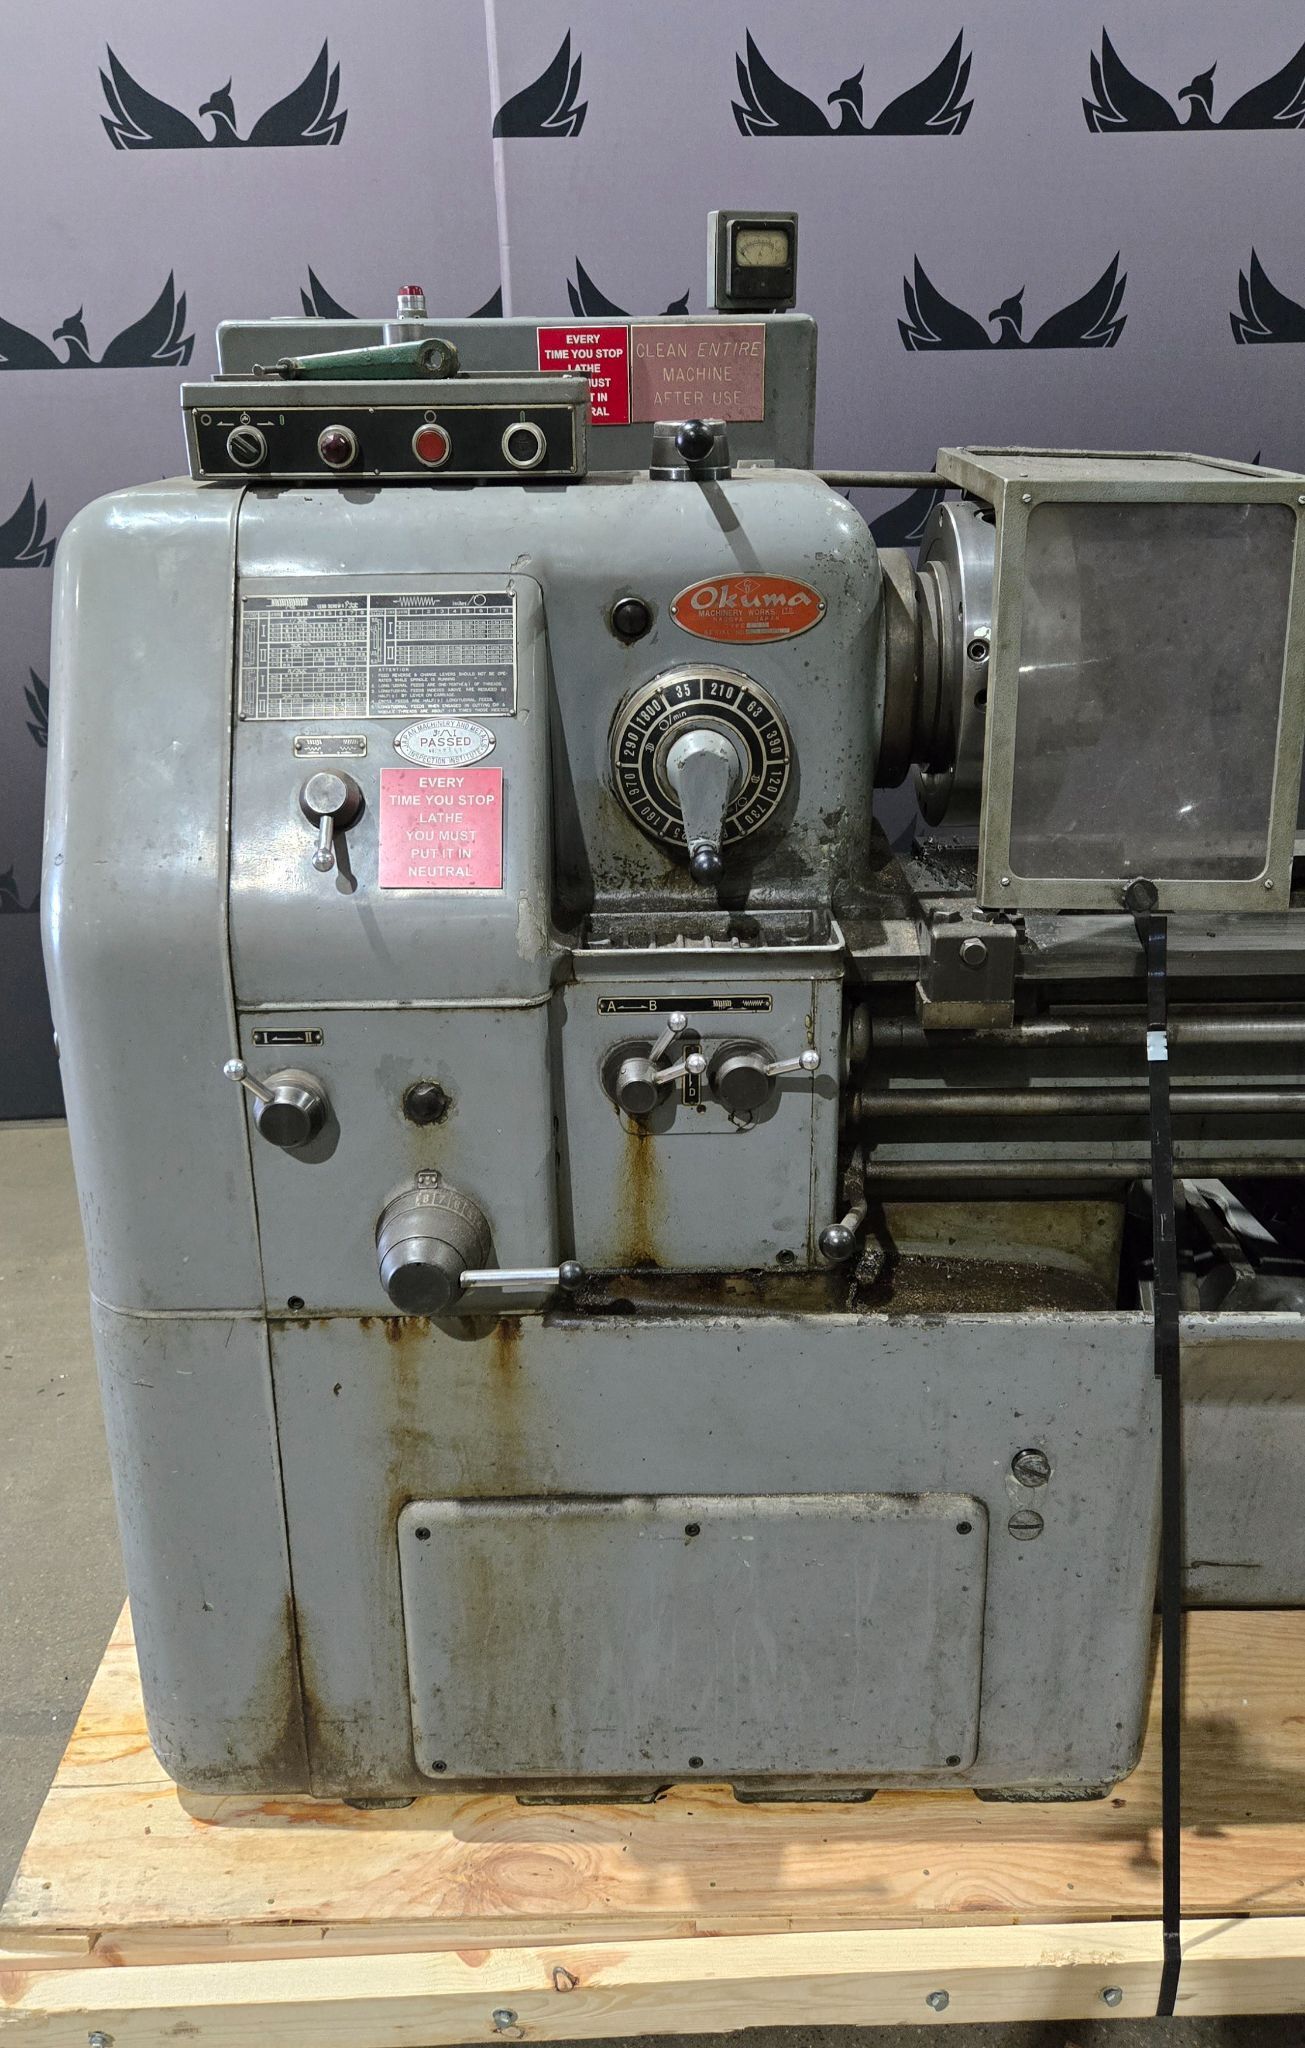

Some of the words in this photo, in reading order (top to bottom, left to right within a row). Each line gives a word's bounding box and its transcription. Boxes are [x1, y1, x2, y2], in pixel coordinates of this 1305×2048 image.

[566, 334, 600, 344] EVERY
[544, 350, 569, 360] TIME
[571, 349, 594, 358] YOU
[596, 349, 624, 358] STOP
[636, 342, 687, 358] CLEAN
[698, 342, 762, 358] ENTIRE
[568, 364, 600, 373] LATHE
[663, 367, 732, 382] MACHINE
[588, 378, 611, 388] UST
[598, 392, 608, 402] IN
[654, 392, 704, 406] AFTER
[713, 391, 742, 405] USE
[690, 584, 812, 610] Okuma
[676, 684, 690, 698] 35
[711, 683, 734, 699] 210
[636, 700, 662, 727] 1800
[746, 701, 762, 718] 63
[401, 728, 416, 748] JAPAN
[418, 721, 455, 732] MACHINERY
[420, 737, 471, 747] PASSED
[624, 732, 638, 757] 290
[766, 730, 782, 754] 390
[409, 750, 446, 764] INSPECTION
[449, 747, 481, 763] INSTITUTE
[419, 777, 464, 788] EVERY
[625, 773, 639, 795] 970
[766, 771, 782, 793] 120
[389, 795, 420, 806] TIME
[425, 795, 454, 805] YOU
[458, 795, 495, 805] STOP
[420, 813, 463, 823] LATHE
[641, 806, 660, 824] 160
[745, 804, 766, 824] 730
[406, 830, 434, 841] YOU
[439, 830, 476, 841] MUST
[411, 849, 438, 858] PUT
[442, 849, 454, 858] IT
[458, 849, 471, 858] IN
[408, 866, 472, 877] NEUTRAL
[606, 1001, 616, 1012] A
[649, 1001, 657, 1011] B
[689, 1088, 695, 1096] D
